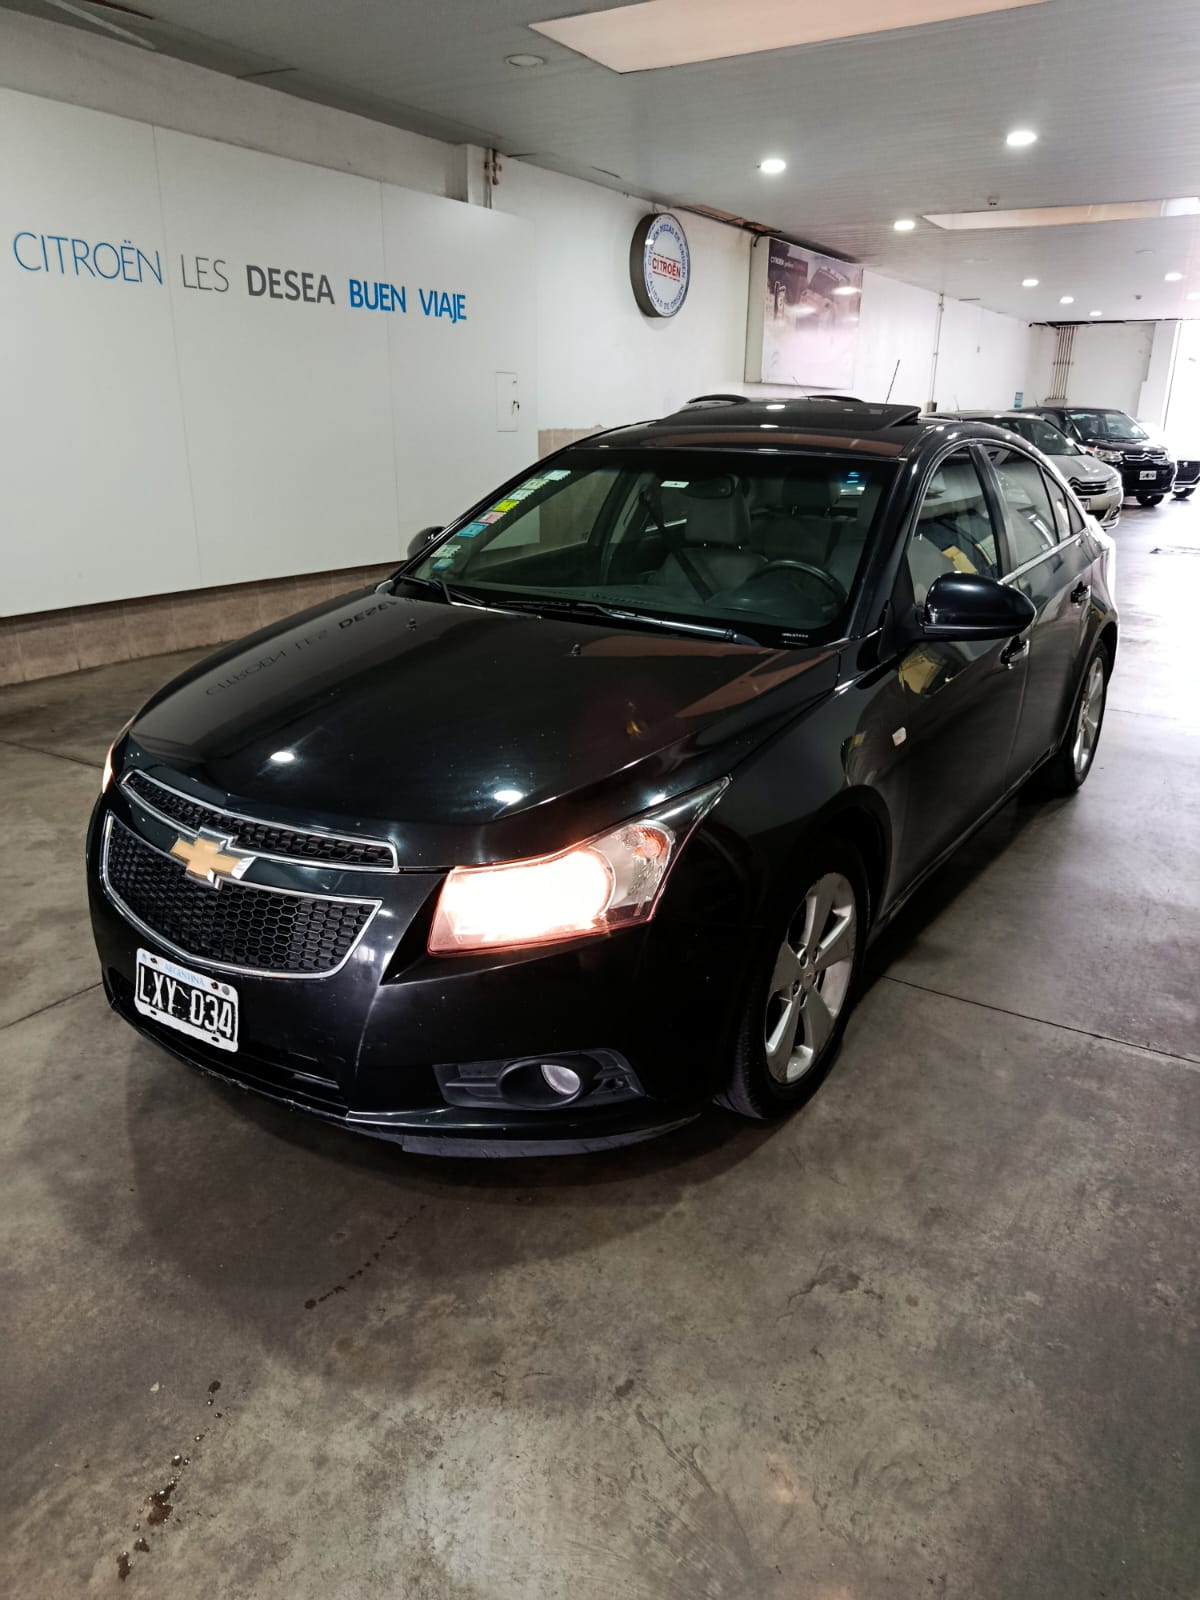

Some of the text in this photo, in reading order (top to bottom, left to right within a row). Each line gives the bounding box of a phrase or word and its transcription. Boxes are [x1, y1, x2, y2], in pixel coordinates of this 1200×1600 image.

[13, 231, 467, 324] CITROËN LES DESEA BUEN VIAJE
[140, 965, 232, 1038] LXY 034
